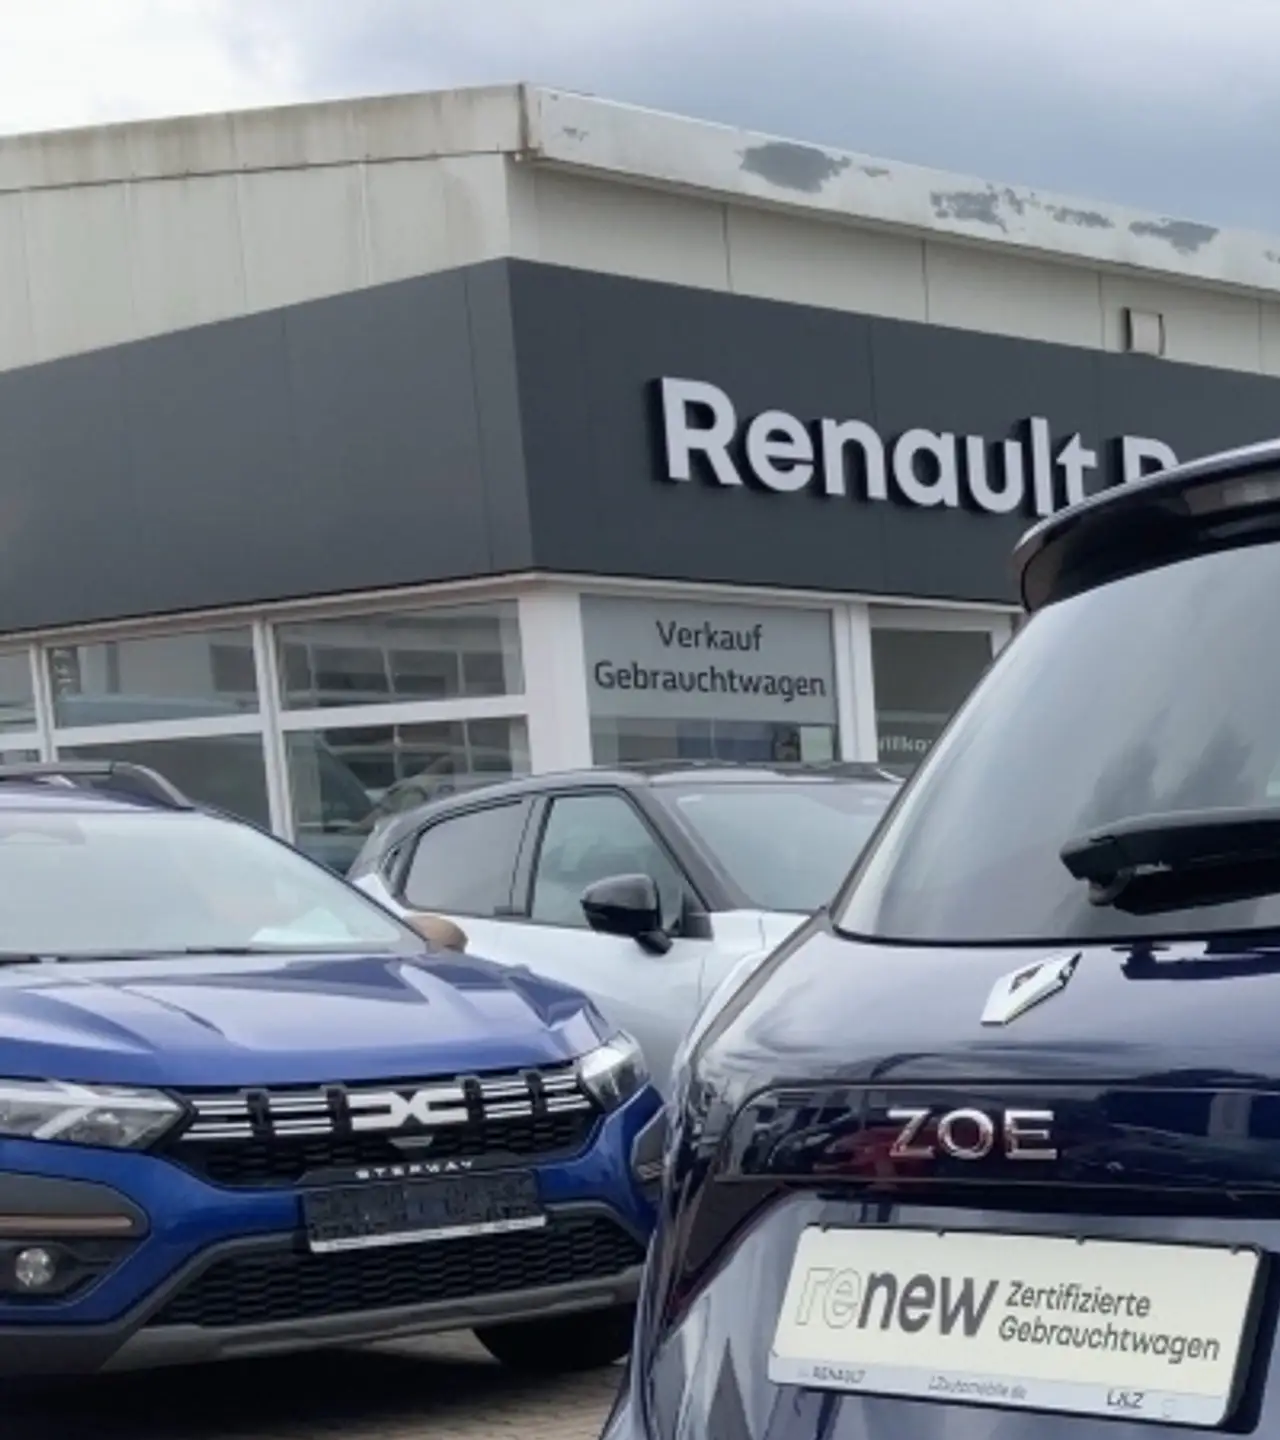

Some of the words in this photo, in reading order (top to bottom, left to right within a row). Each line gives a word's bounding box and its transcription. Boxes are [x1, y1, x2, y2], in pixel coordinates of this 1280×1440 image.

[661, 375, 1098, 515] Renault
[655, 619, 763, 651] Verkauf
[594, 659, 827, 702] Gebrauchtwagen
[886, 1107, 1057, 1160] ZOE
[795, 1266, 1000, 1337] renew
[1005, 1280, 1151, 1318] Zertifizierte
[999, 1314, 1220, 1364] Gebrauchtwagen
